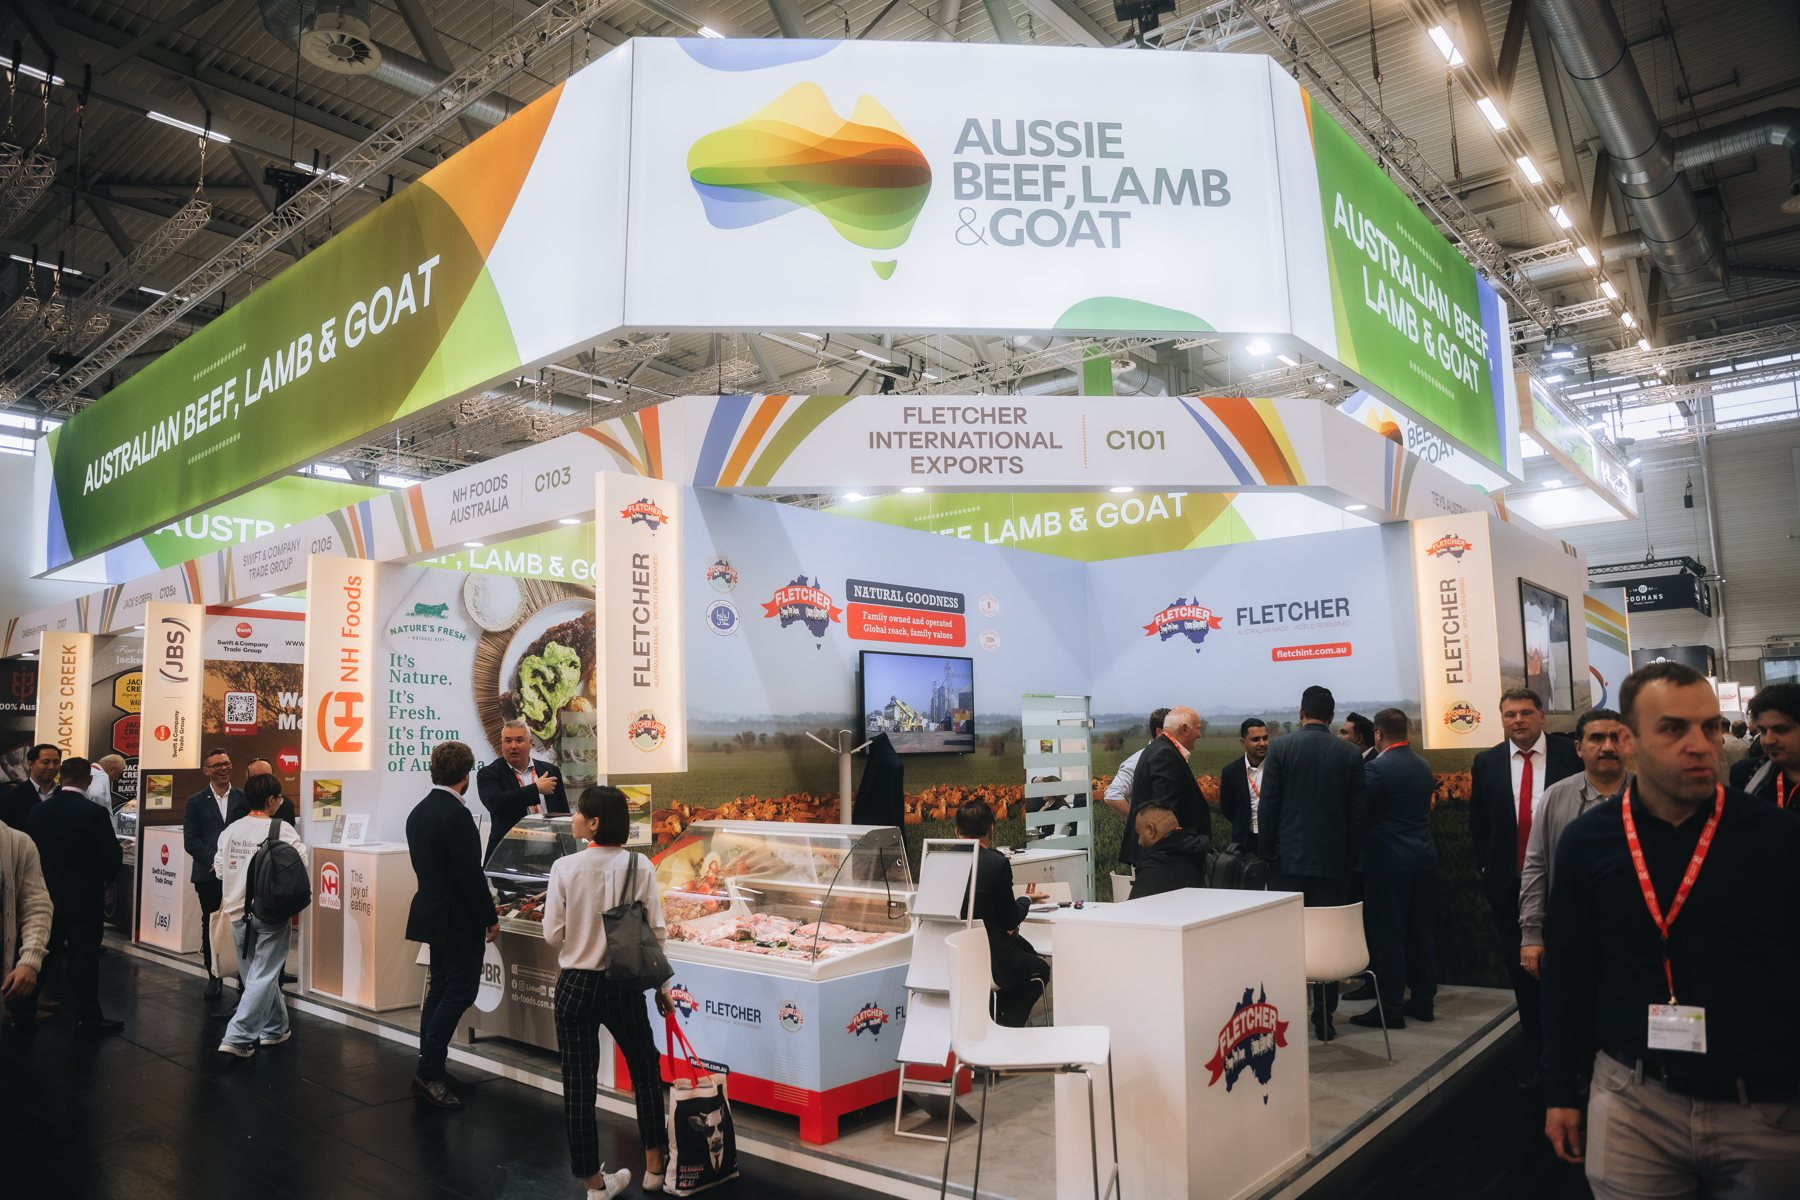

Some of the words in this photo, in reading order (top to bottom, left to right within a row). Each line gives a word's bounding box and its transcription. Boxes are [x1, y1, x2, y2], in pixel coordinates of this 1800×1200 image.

[953, 118, 1125, 159] AUSSIE
[1333, 191, 1451, 329] AUSTRALIAN
[1453, 302, 1493, 371] BEEF,
[1362, 265, 1420, 344] LAMB
[1422, 317, 1436, 360] &
[1437, 332, 1479, 394] GOAT
[83, 410, 181, 496] AUSTRALIAN
[183, 376, 239, 441] BEEF,
[245, 332, 313, 407] LAMB
[318, 316, 337, 363] &
[344, 254, 440, 348] GOAT
[903, 406, 1027, 425] FLETCHER
[869, 431, 1063, 450] INTERNATIONAL
[1106, 430, 1166, 450] C101
[910, 455, 1024, 474] EXPORTS
[452, 485, 468, 504] NH
[469, 473, 508, 500] FOODS
[534, 466, 571, 493] C103
[450, 494, 510, 525] AUSTRALIA
[628, 502, 662, 517] FLETCHER
[983, 511, 1062, 545] LAMB
[1069, 507, 1088, 532] &
[1095, 492, 1188, 528] GOAT
[243, 549, 262, 567] SWIFT
[267, 538, 301, 560] COMPANY
[311, 535, 332, 554] C105
[1432, 538, 1466, 550] FLETCHER
[248, 563, 269, 580] TRADE
[269, 556, 294, 575] GROUP
[469, 548, 543, 575] LAMB
[549, 556, 565, 578] &
[341, 575, 362, 638] Foods
[774, 587, 831, 612] FLETCHER
[853, 584, 904, 603] NATURAL
[905, 591, 959, 609] GOODNESS
[632, 552, 651, 687] FLETCHER
[862, 611, 888, 623] Family
[889, 615, 911, 625] owned
[912, 616, 924, 626] and
[925, 618, 953, 629] operated
[1154, 606, 1211, 627] FLETCHER
[1236, 597, 1351, 627] FLETCHER
[389, 624, 435, 636] NATURE'S
[437, 626, 467, 642] FRESH
[863, 623, 887, 634] Global
[910, 628, 932, 640] family
[932, 630, 953, 640] values
[1236, 627, 1272, 636] AUSTRALIAN
[1439, 578, 1464, 684] FLETCHER
[240, 640, 269, 649] Company
[1276, 645, 1347, 658] fletchint.com.au
[60, 644, 77, 696] CREEK
[340, 648, 359, 682] NH
[389, 669, 452, 686] Nature.
[388, 705, 440, 720] Fresh.
[57, 701, 74, 756] JACK'S
[419, 725, 460, 740] from
[388, 741, 415, 756] the
[387, 757, 406, 772] of
[321, 874, 339, 895] NH
[350, 869, 363, 883] The
[350, 883, 361, 899] joy
[361, 886, 369, 897] of
[350, 899, 371, 916] eating
[705, 999, 762, 1023] FLETCHER
[853, 1008, 883, 1025] FLETCHER
[1219, 1005, 1277, 1058] FLETCHER
